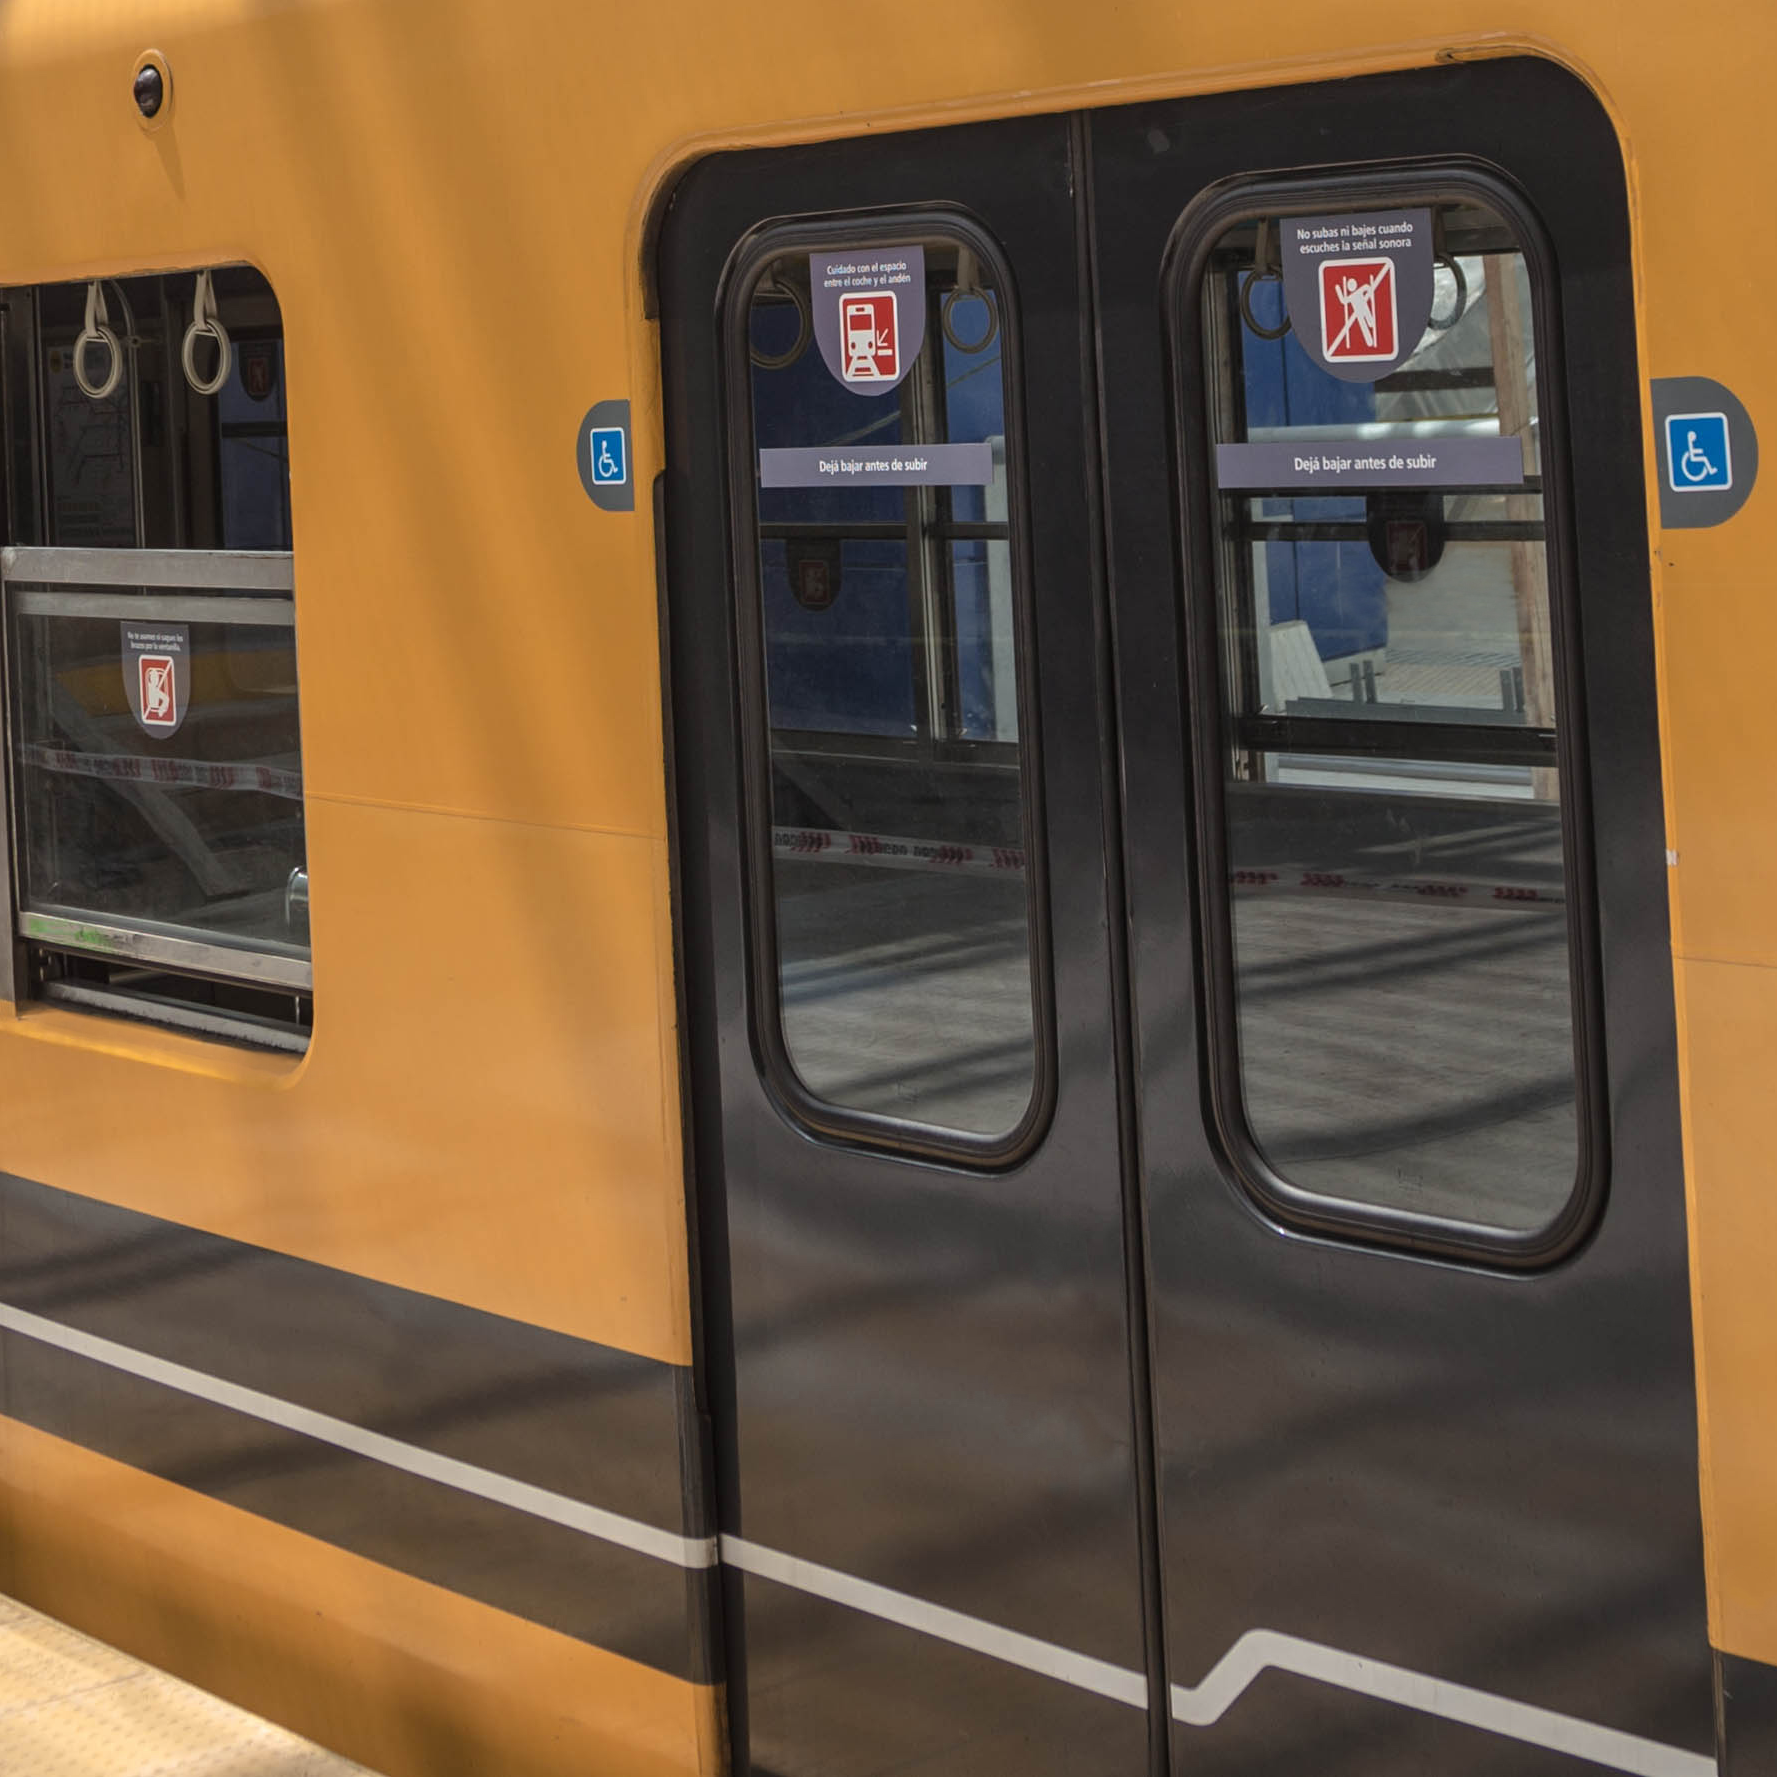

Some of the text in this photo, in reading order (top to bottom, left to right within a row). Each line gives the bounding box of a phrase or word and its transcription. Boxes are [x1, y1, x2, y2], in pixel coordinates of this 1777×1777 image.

[1297, 221, 1413, 240] No subas ni bajes cuando
[1300, 237, 1412, 254] escuches la señal sonora
[827, 261, 907, 275] Cuidado con el espacio
[824, 273, 911, 288] entre el coche y el andén
[819, 457, 927, 475] Dejá bajar antes de subir
[1294, 454, 1437, 474] Dejá bajar antes de subir
